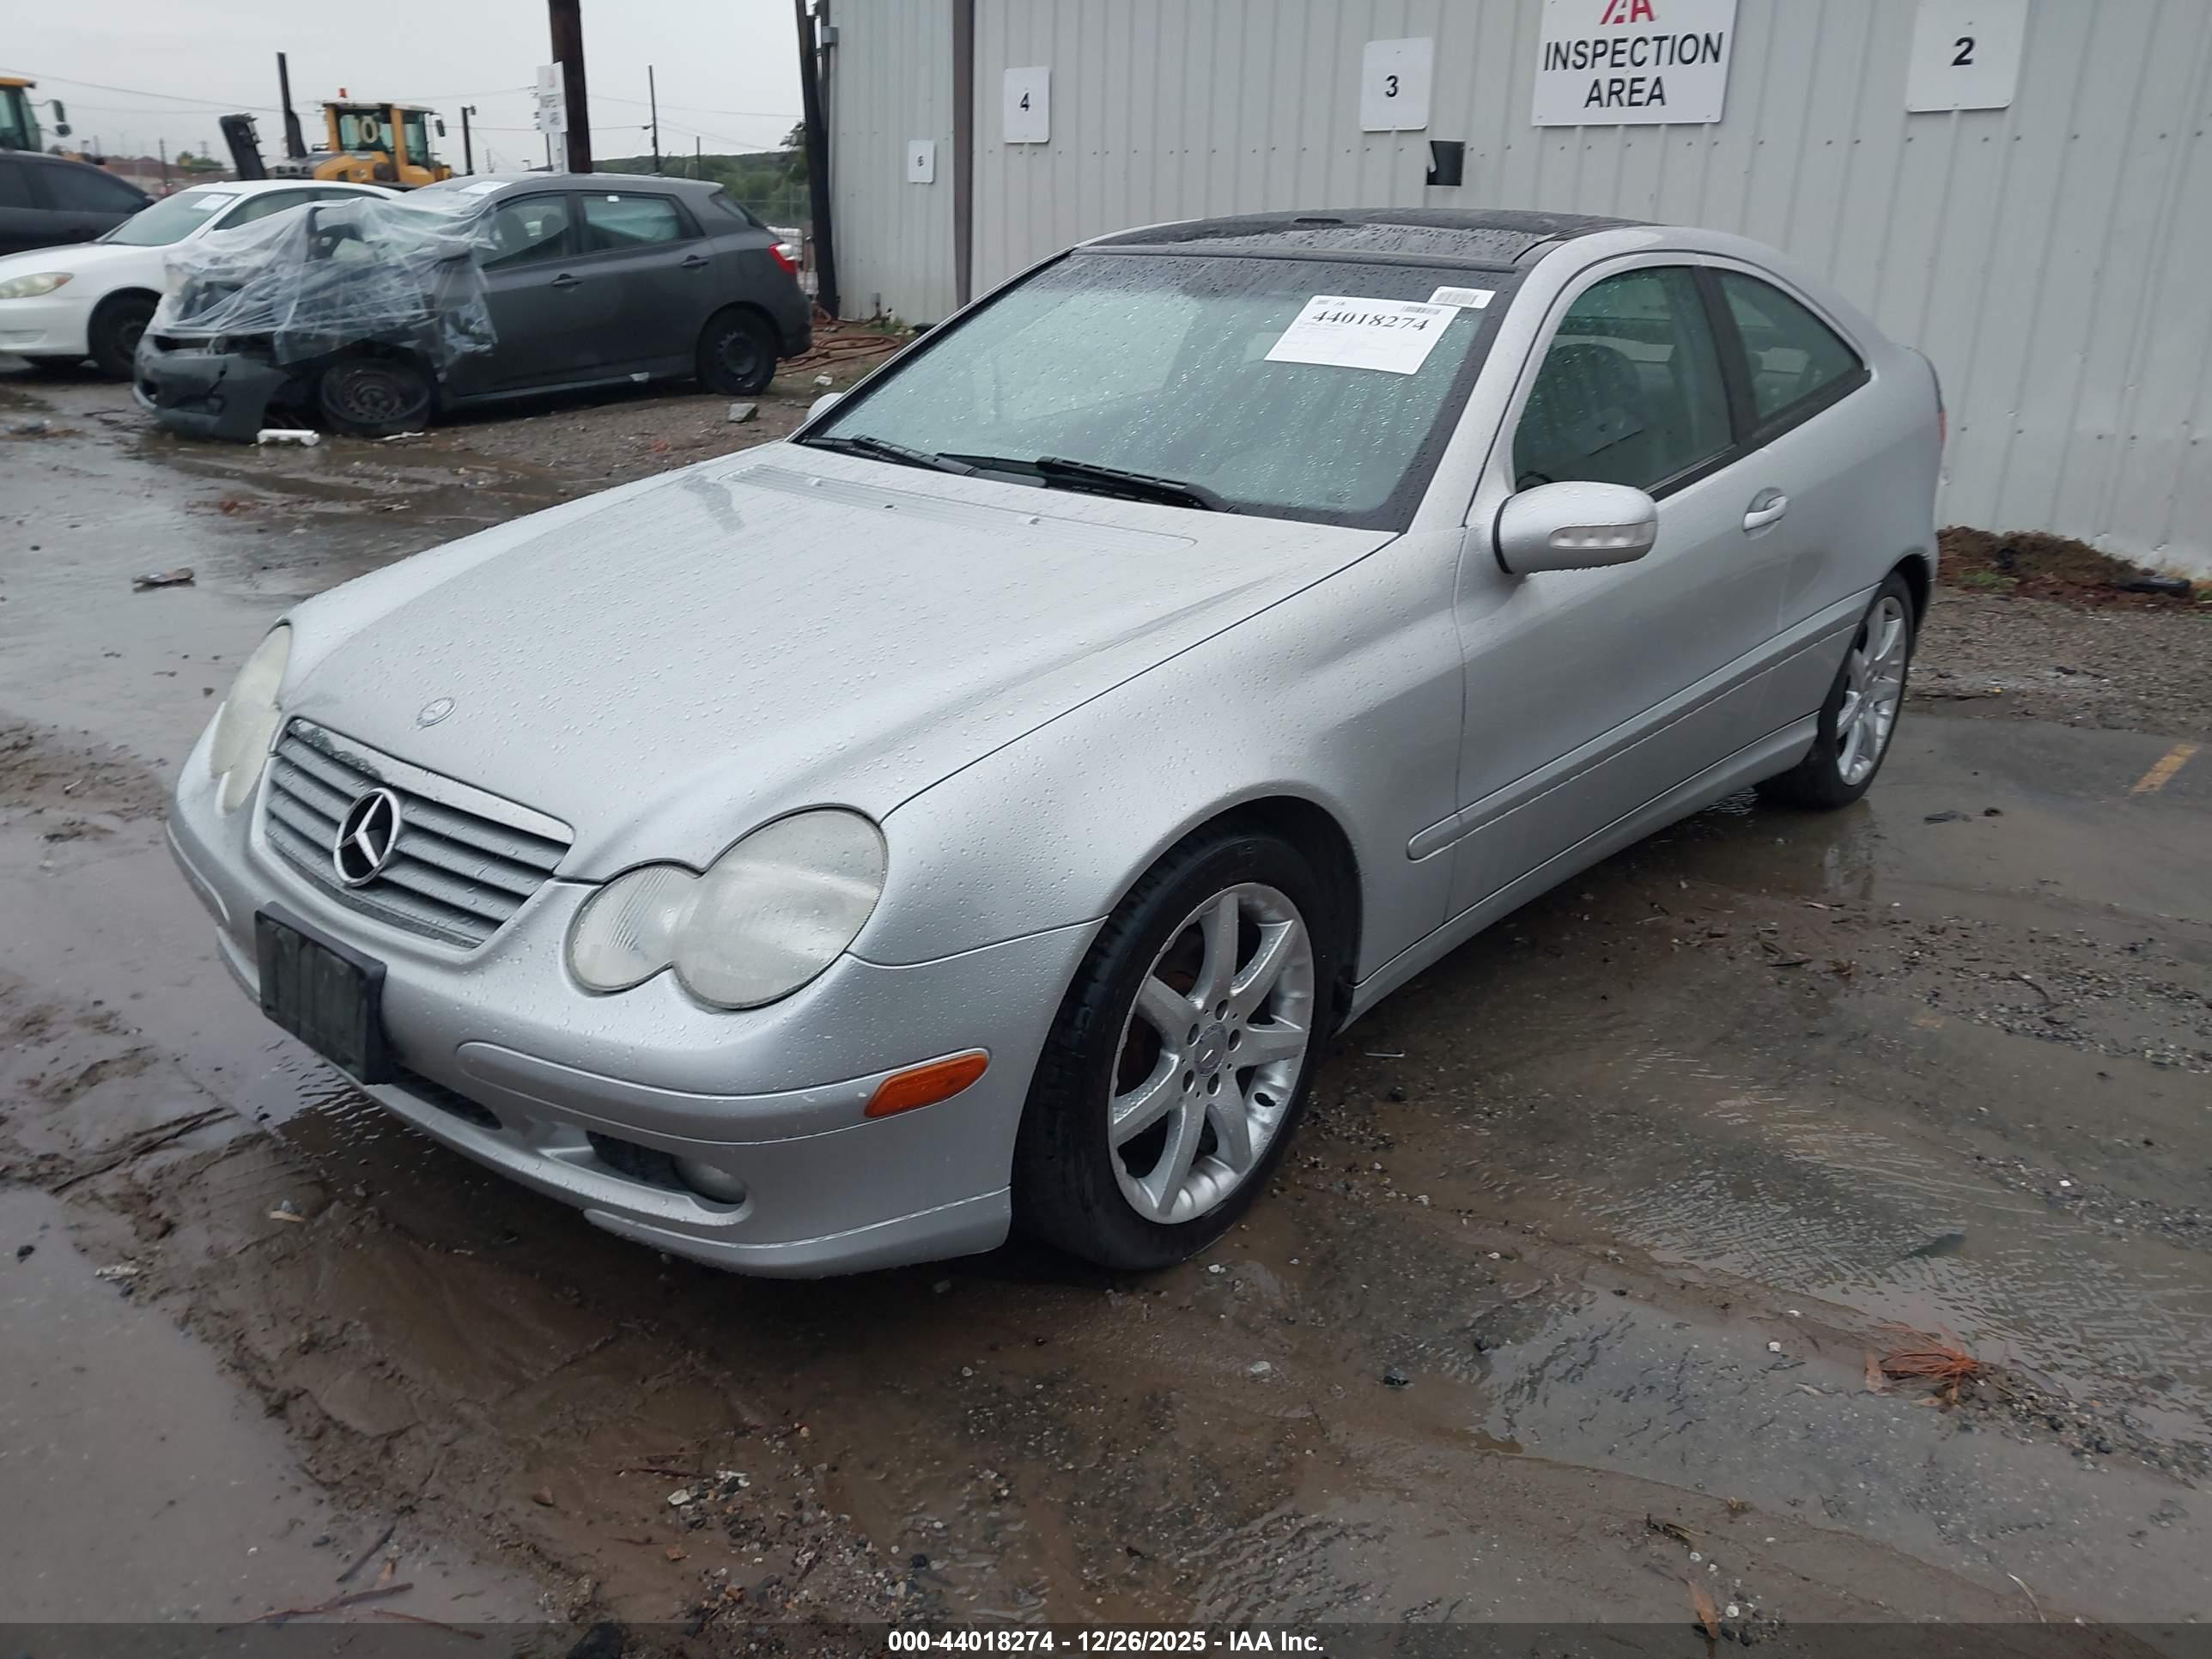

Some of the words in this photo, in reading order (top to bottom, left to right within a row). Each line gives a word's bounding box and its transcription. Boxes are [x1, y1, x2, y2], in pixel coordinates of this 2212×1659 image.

[1543, 32, 1723, 71] INSPECTION
[1950, 36, 1975, 66] 2
[1385, 75, 1398, 97] 3
[1583, 76, 1666, 108] AREA
[1019, 92, 1030, 112] 4
[1311, 310, 1431, 331] 44018274
